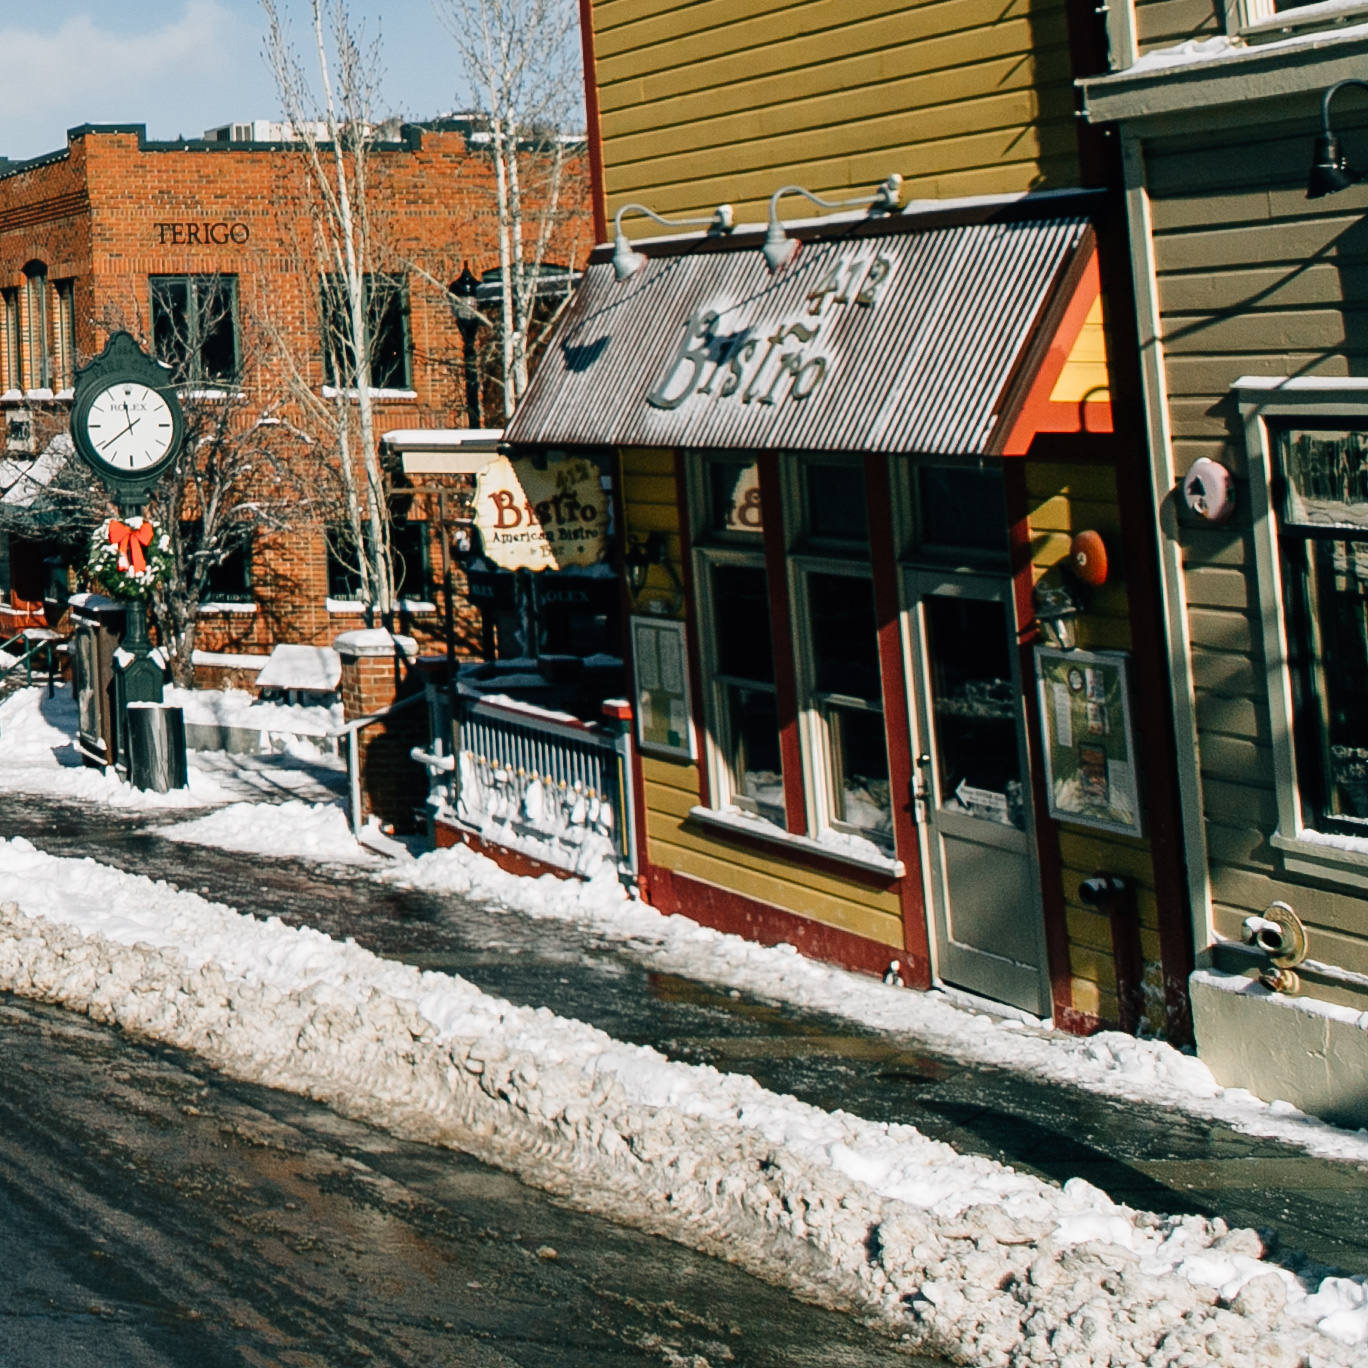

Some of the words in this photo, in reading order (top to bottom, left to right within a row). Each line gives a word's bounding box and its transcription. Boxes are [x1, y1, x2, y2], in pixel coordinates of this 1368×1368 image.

[153, 222, 250, 245] TERIGO
[645, 310, 827, 411] Bistro
[110, 403, 148, 412] ROEX
[487, 489, 598, 529] Bistro
[493, 531, 555, 544] American
[557, 527, 599, 541] Bistro
[546, 589, 591, 602] OLEX
